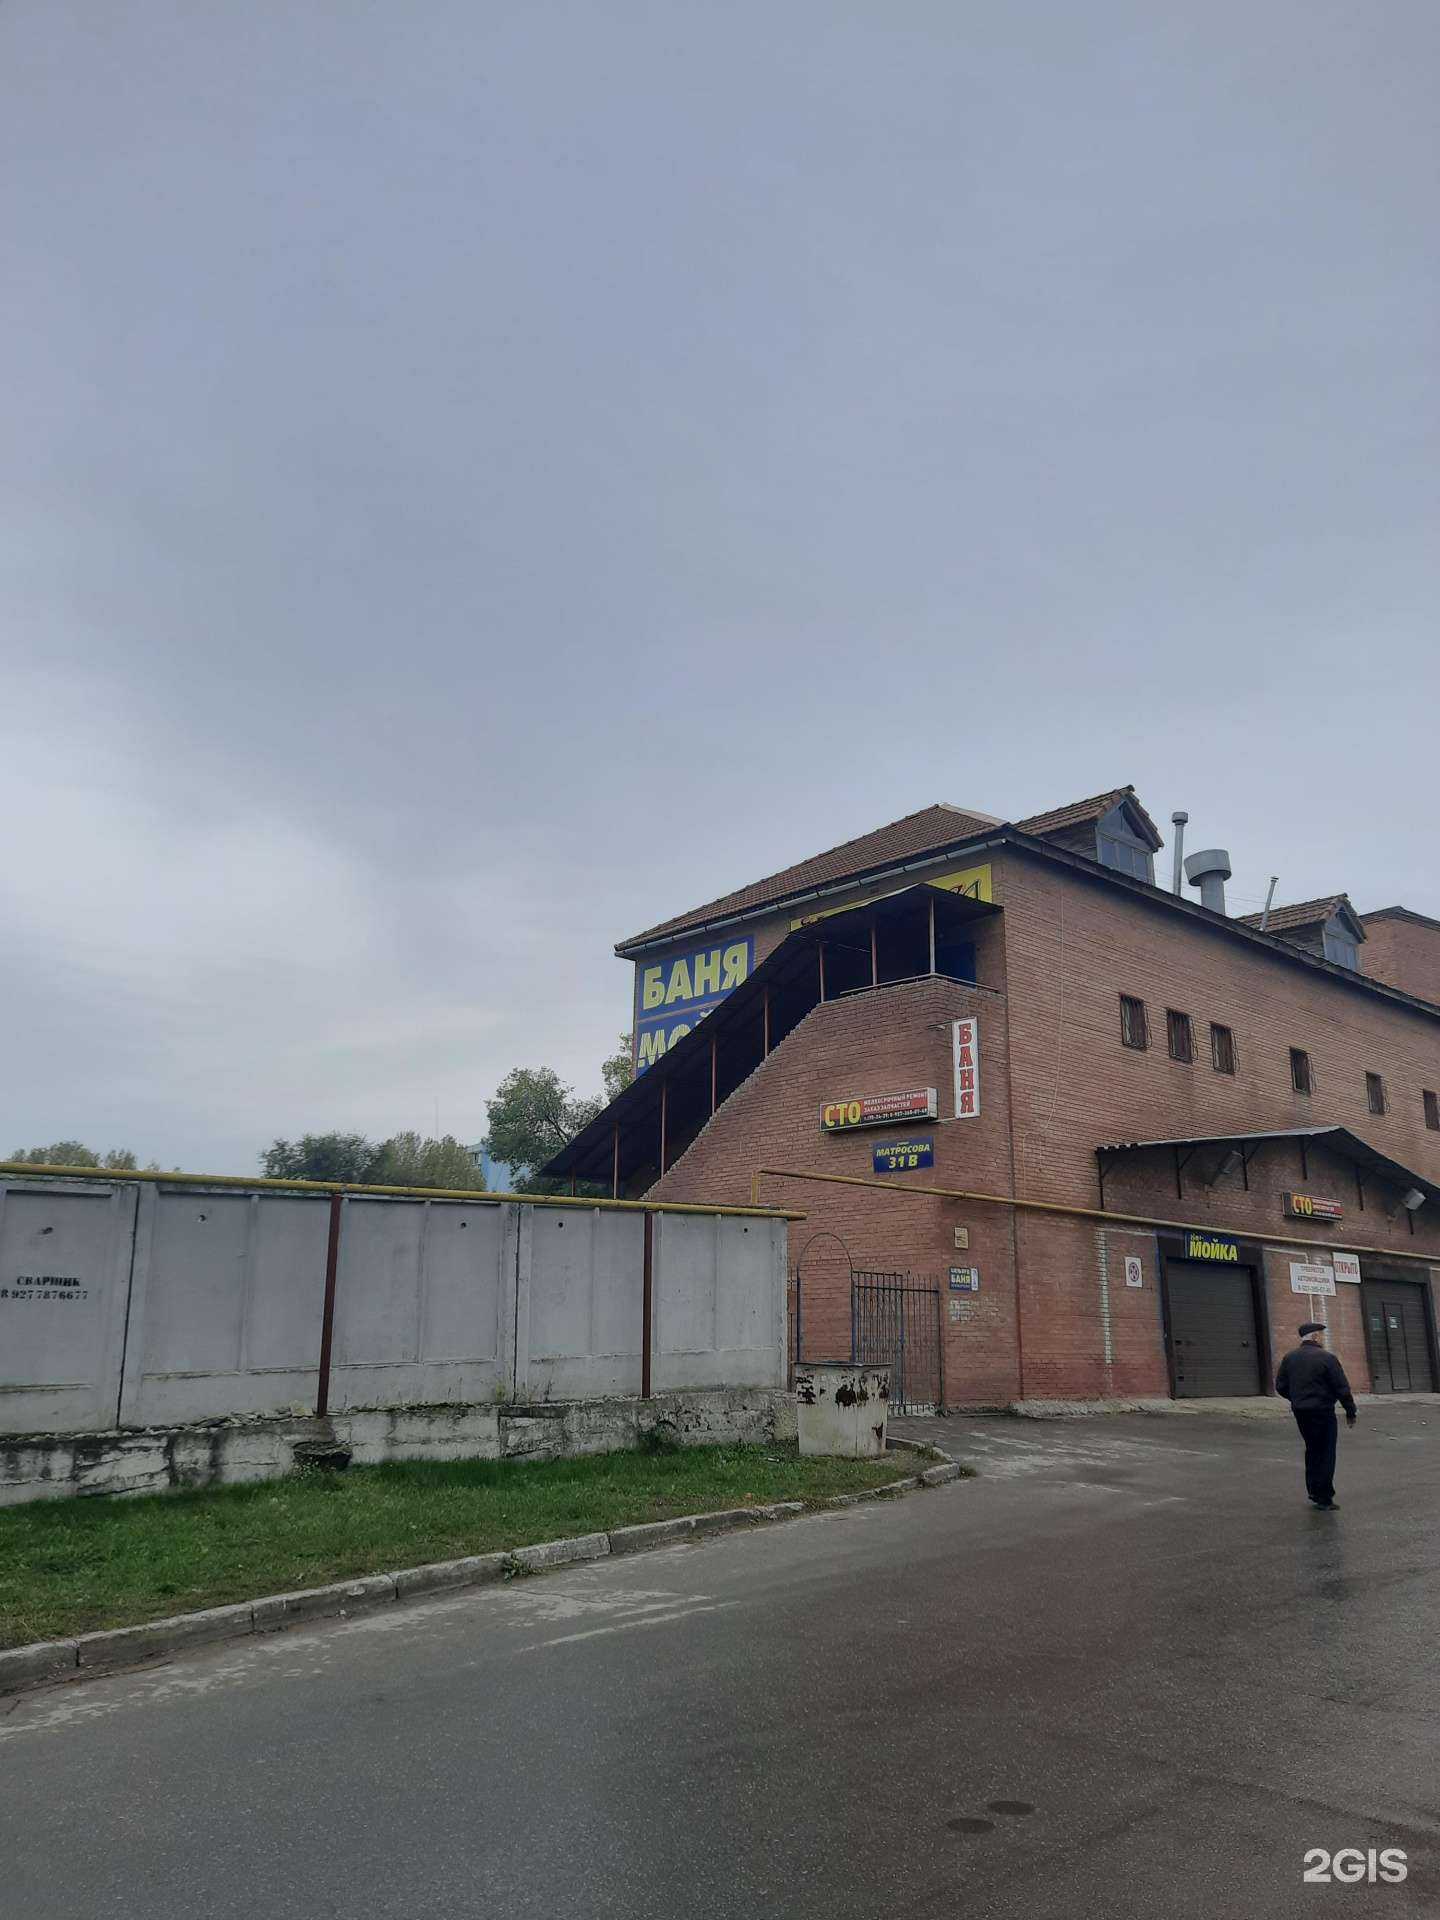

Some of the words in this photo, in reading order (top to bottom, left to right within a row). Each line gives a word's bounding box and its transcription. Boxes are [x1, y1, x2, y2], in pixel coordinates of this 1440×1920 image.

[643, 942, 748, 1010] БАНЯ
[959, 1023, 975, 1114] БАНЯ
[824, 1101, 861, 1127] СТО
[876, 1143, 930, 1157] МАТРОСОВА
[1293, 1195, 1312, 1215] СТО
[1189, 1239, 1239, 1262] МОЙКА
